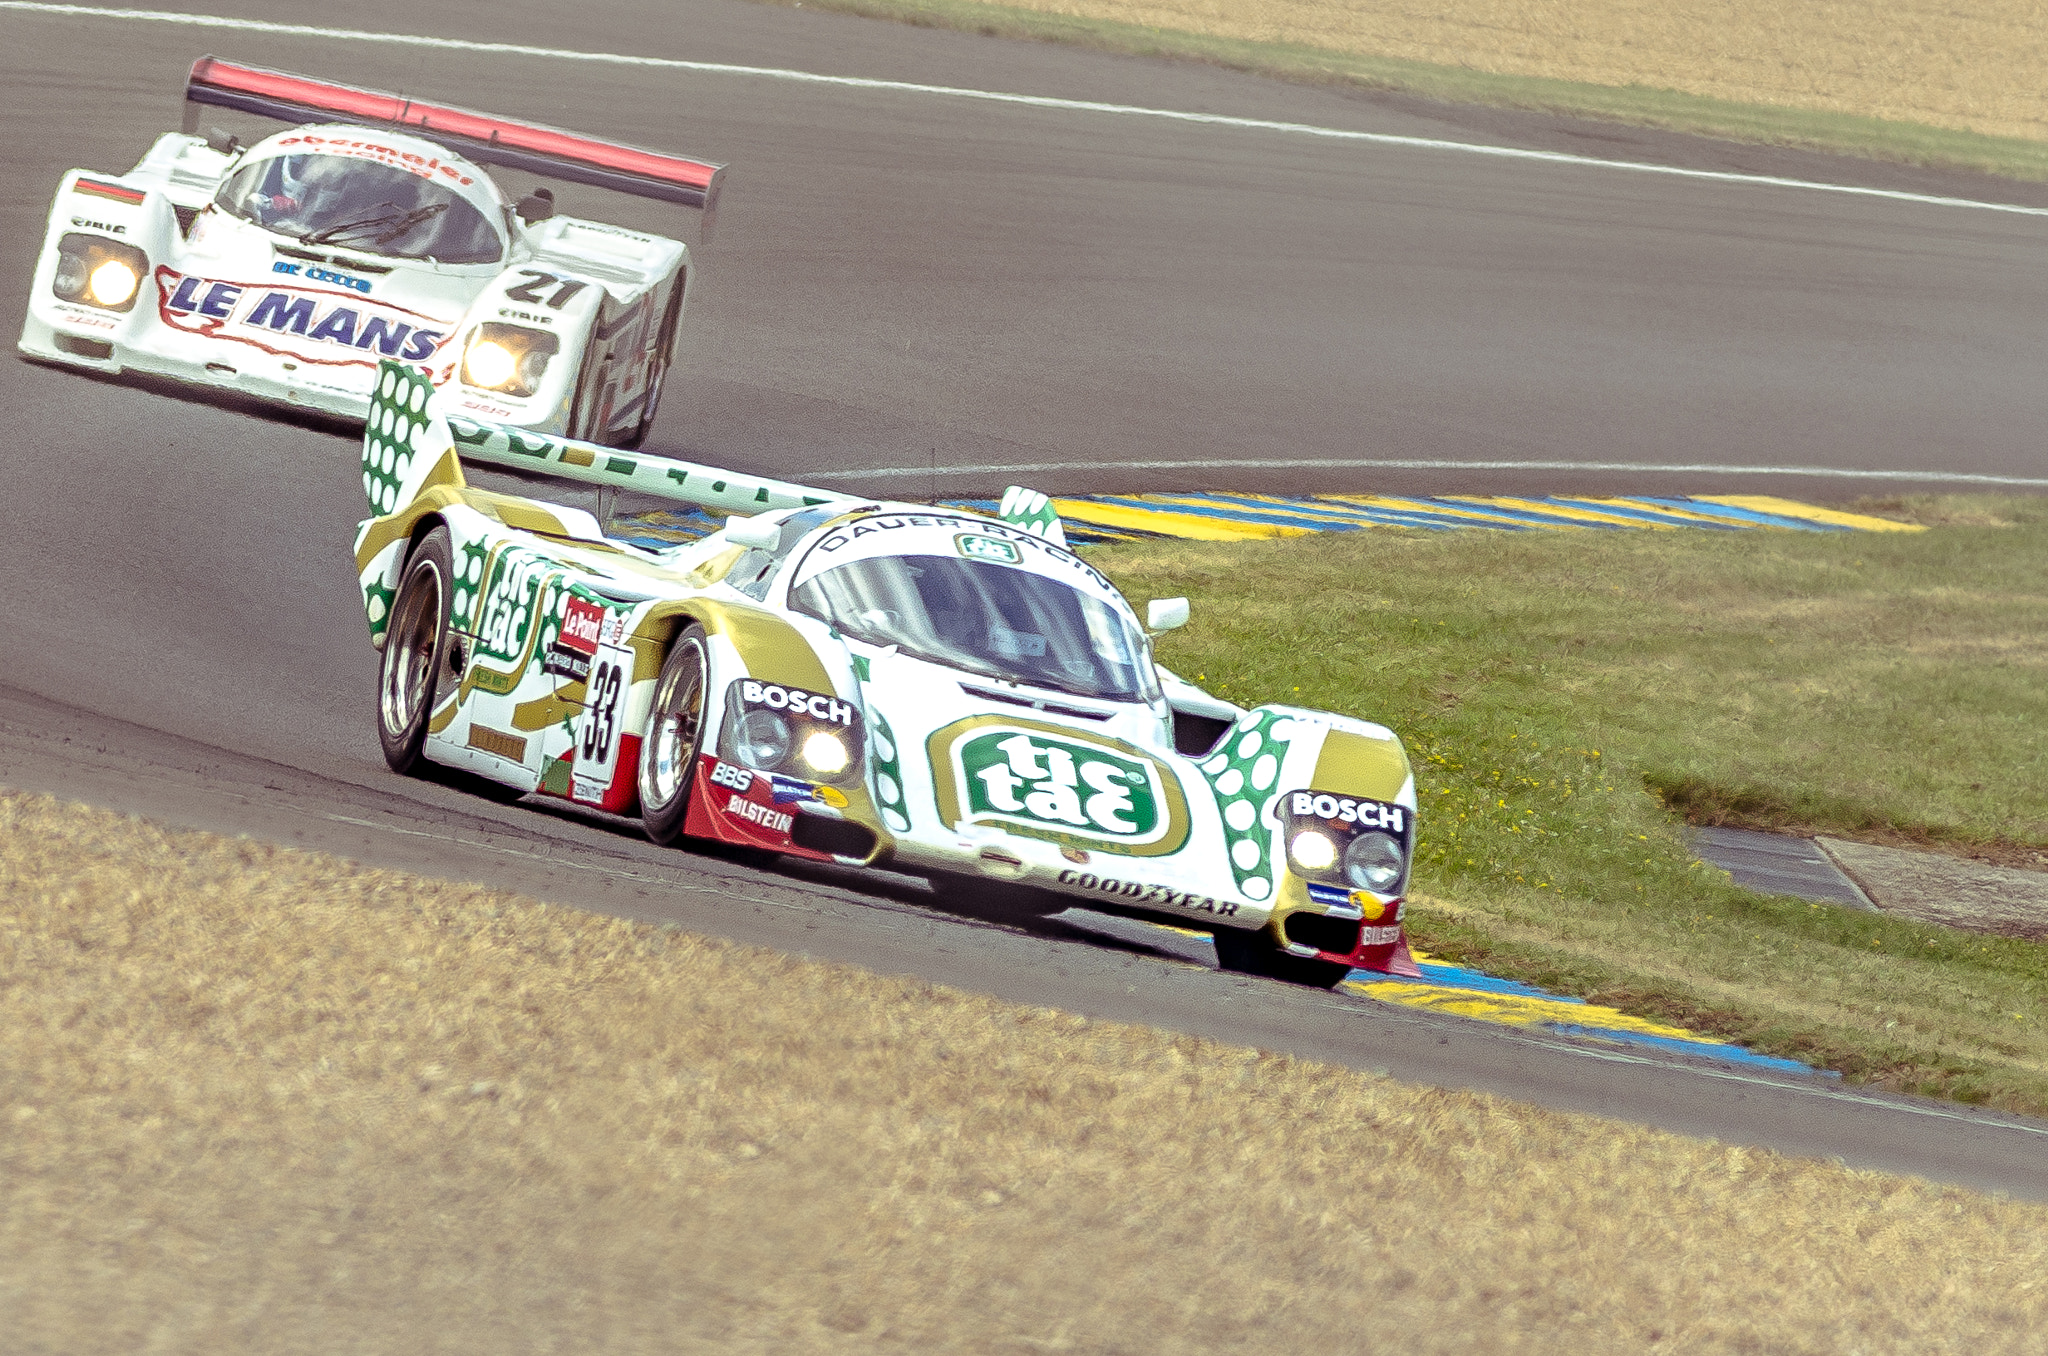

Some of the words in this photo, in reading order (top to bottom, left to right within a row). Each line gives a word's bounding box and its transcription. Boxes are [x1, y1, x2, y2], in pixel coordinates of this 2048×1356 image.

[166, 276, 243, 320] LE
[246, 291, 445, 361] MANS
[583, 660, 622, 765] 33
[743, 680, 852, 726] BOSCH
[710, 761, 754, 791] BBS
[996, 735, 1132, 798] tic
[728, 794, 794, 833] BILSTEIN
[976, 761, 1140, 834] tac
[1293, 792, 1404, 832] BOSCH
[1058, 868, 1241, 917] GOODYEAR
